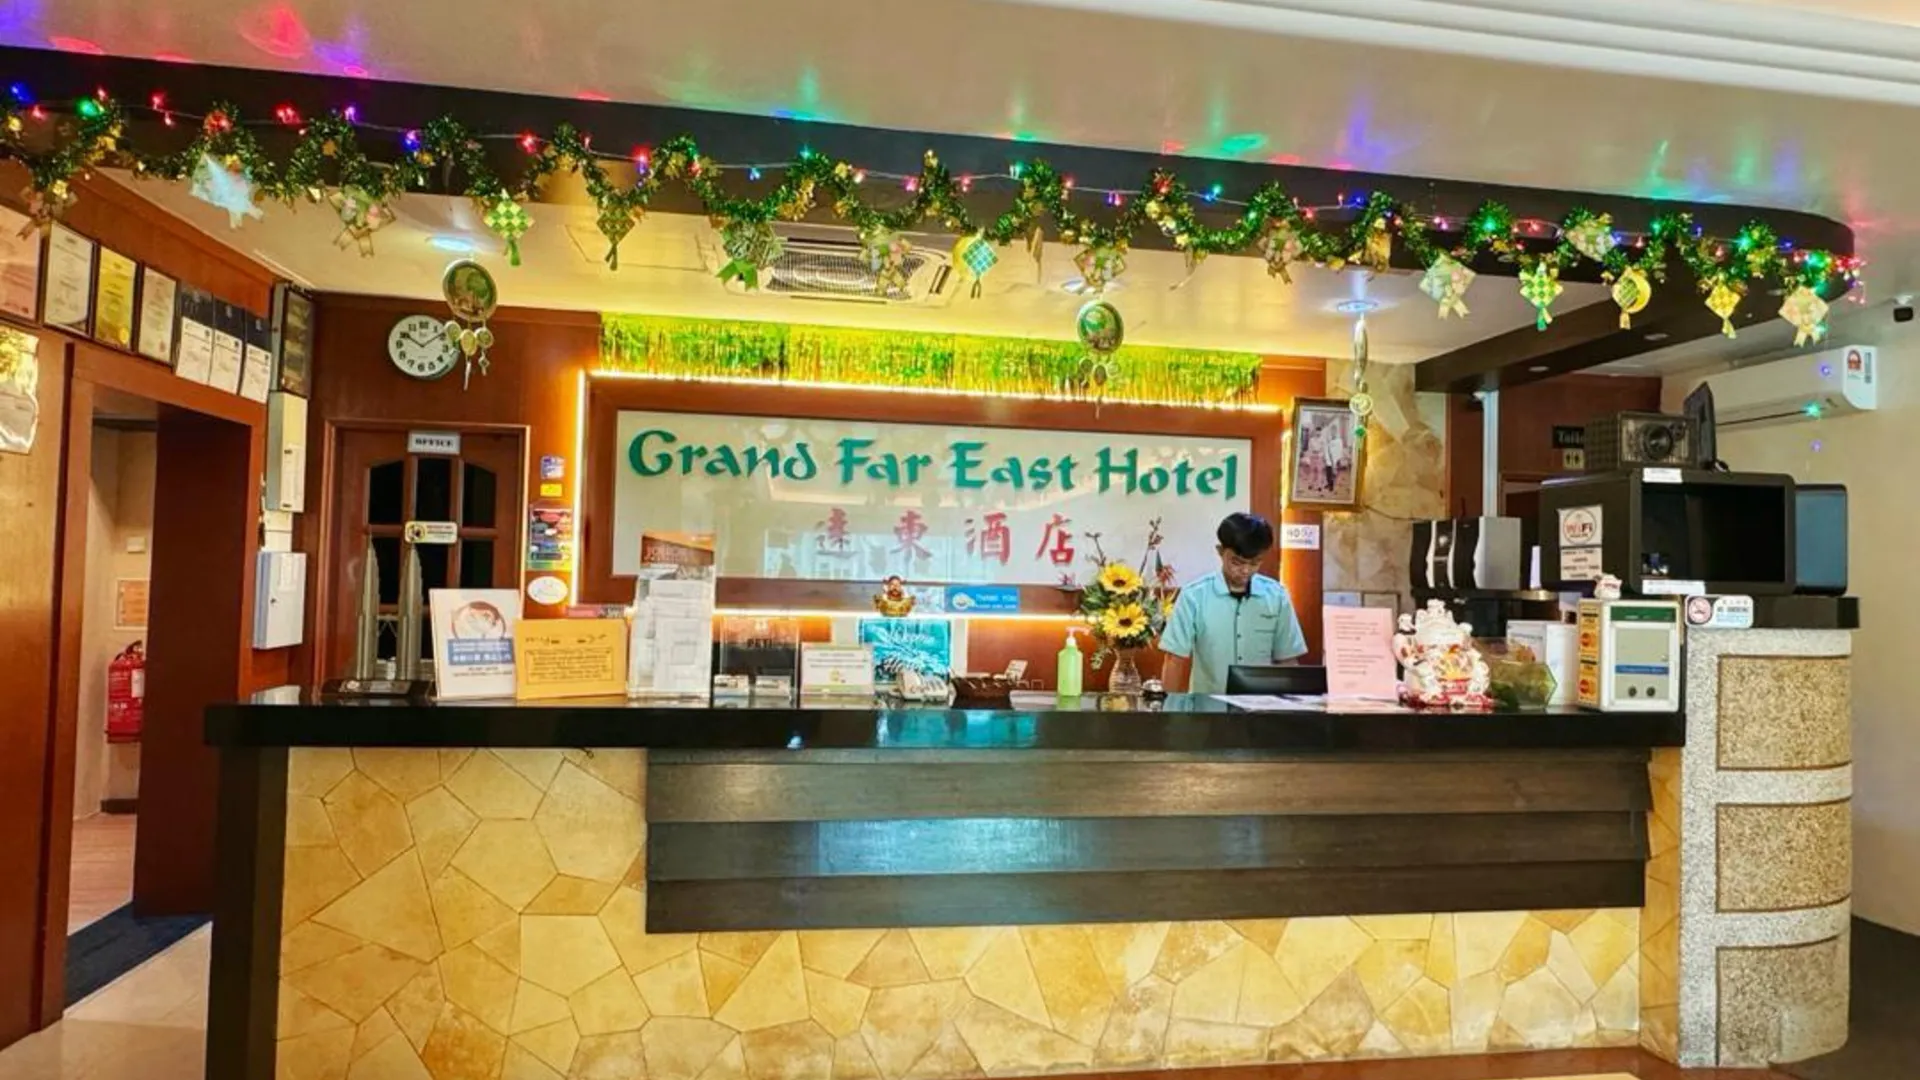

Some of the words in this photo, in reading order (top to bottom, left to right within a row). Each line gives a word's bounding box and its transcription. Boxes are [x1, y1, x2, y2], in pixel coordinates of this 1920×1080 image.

[415, 437, 453, 447] OFFICE
[627, 430, 818, 481] Grand
[839, 436, 931, 489] Far
[950, 440, 1076, 490] East
[1094, 445, 1239, 500] Hotel
[1566, 522, 1593, 533] WiFi
